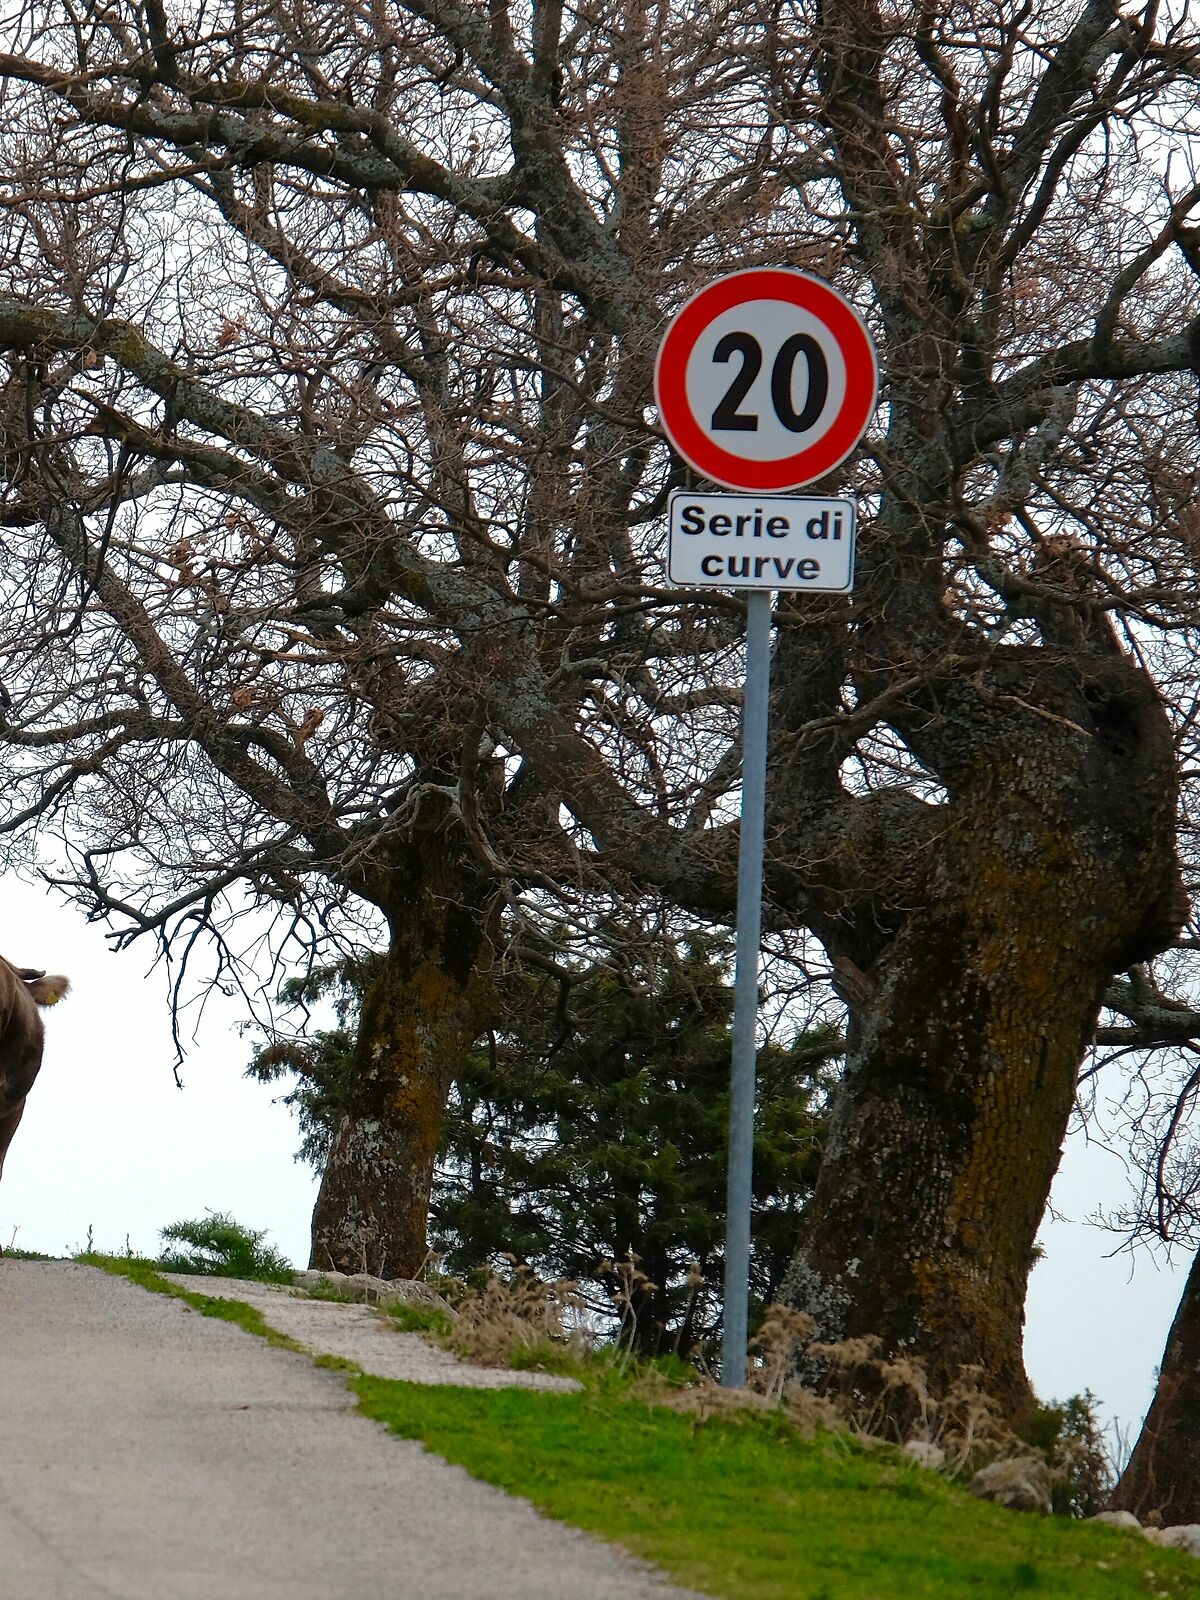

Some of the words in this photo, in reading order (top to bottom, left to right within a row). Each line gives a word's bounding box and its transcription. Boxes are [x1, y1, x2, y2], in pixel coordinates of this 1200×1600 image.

[711, 331, 829, 433] 20
[680, 505, 790, 538] Serie
[806, 510, 843, 540] di
[701, 554, 820, 580] curve
